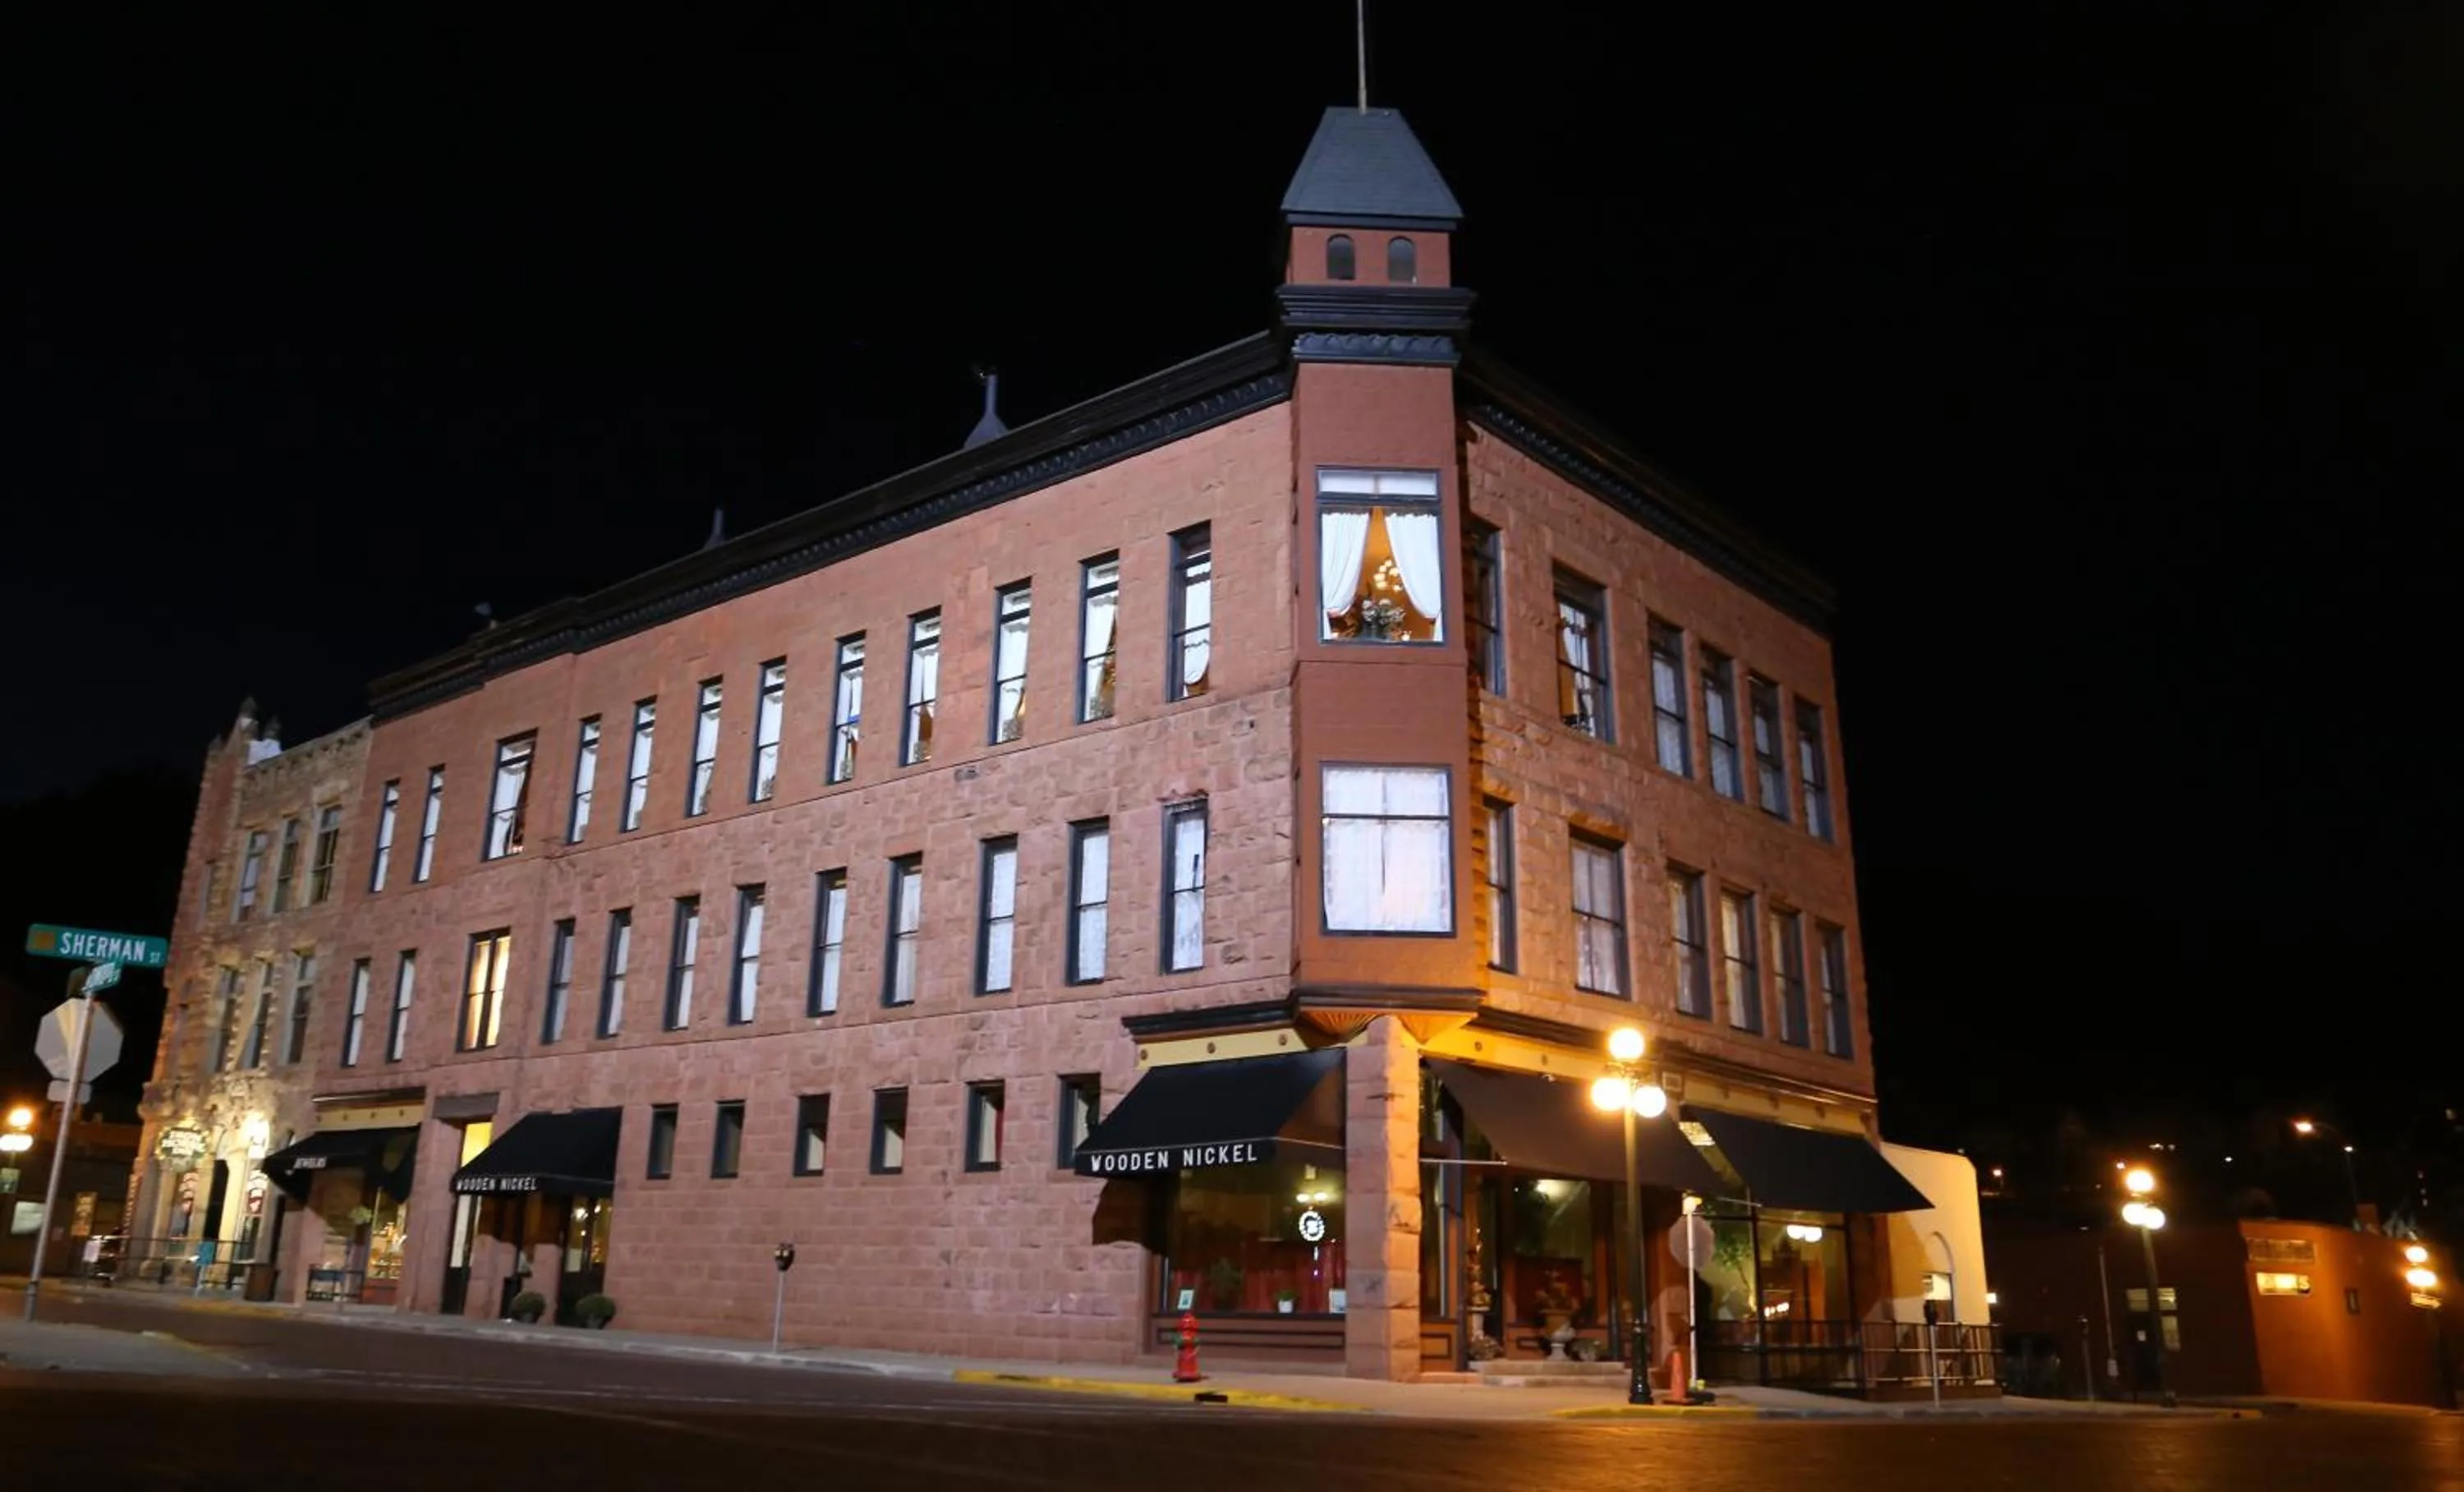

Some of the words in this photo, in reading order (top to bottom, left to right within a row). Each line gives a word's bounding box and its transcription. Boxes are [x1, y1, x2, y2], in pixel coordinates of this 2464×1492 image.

[59, 932, 146, 963] SHERMAN
[1090, 1150, 1170, 1172] WOODEN
[1182, 1143, 1258, 1167] NICKEL
[457, 1177, 495, 1191] WOODEN
[499, 1177, 537, 1190] NICKEL
